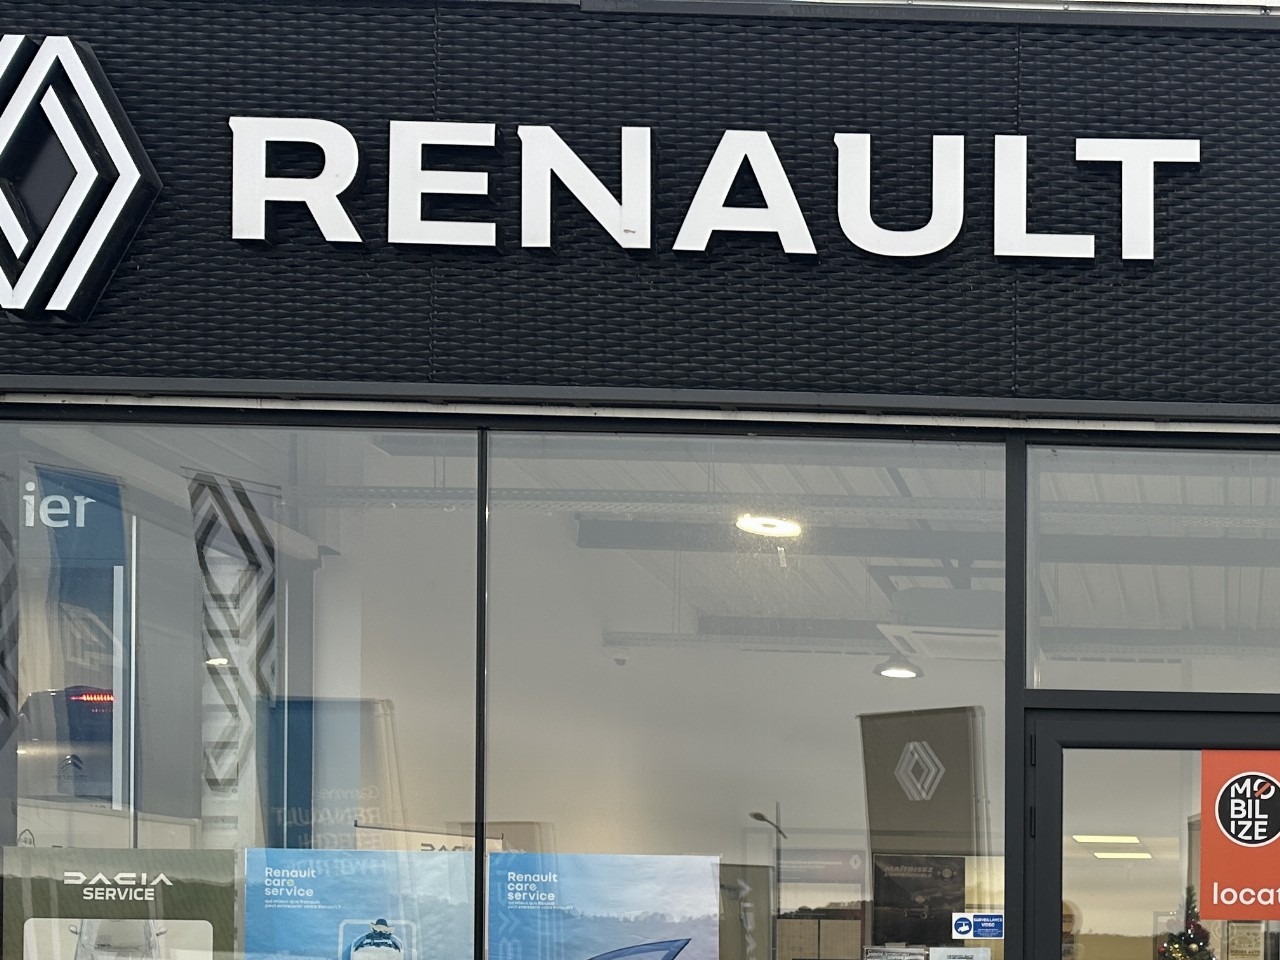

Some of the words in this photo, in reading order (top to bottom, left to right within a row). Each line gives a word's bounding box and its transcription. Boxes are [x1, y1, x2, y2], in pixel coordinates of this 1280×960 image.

[229, 116, 1201, 261] RENAULT
[264, 866, 316, 878] Renault
[507, 871, 558, 883] Renault
[64, 871, 173, 886] DACIA
[264, 878, 295, 887] care
[264, 886, 314, 897] service
[507, 882, 538, 891] care
[83, 887, 155, 901] SERVICE
[507, 890, 556, 901] service
